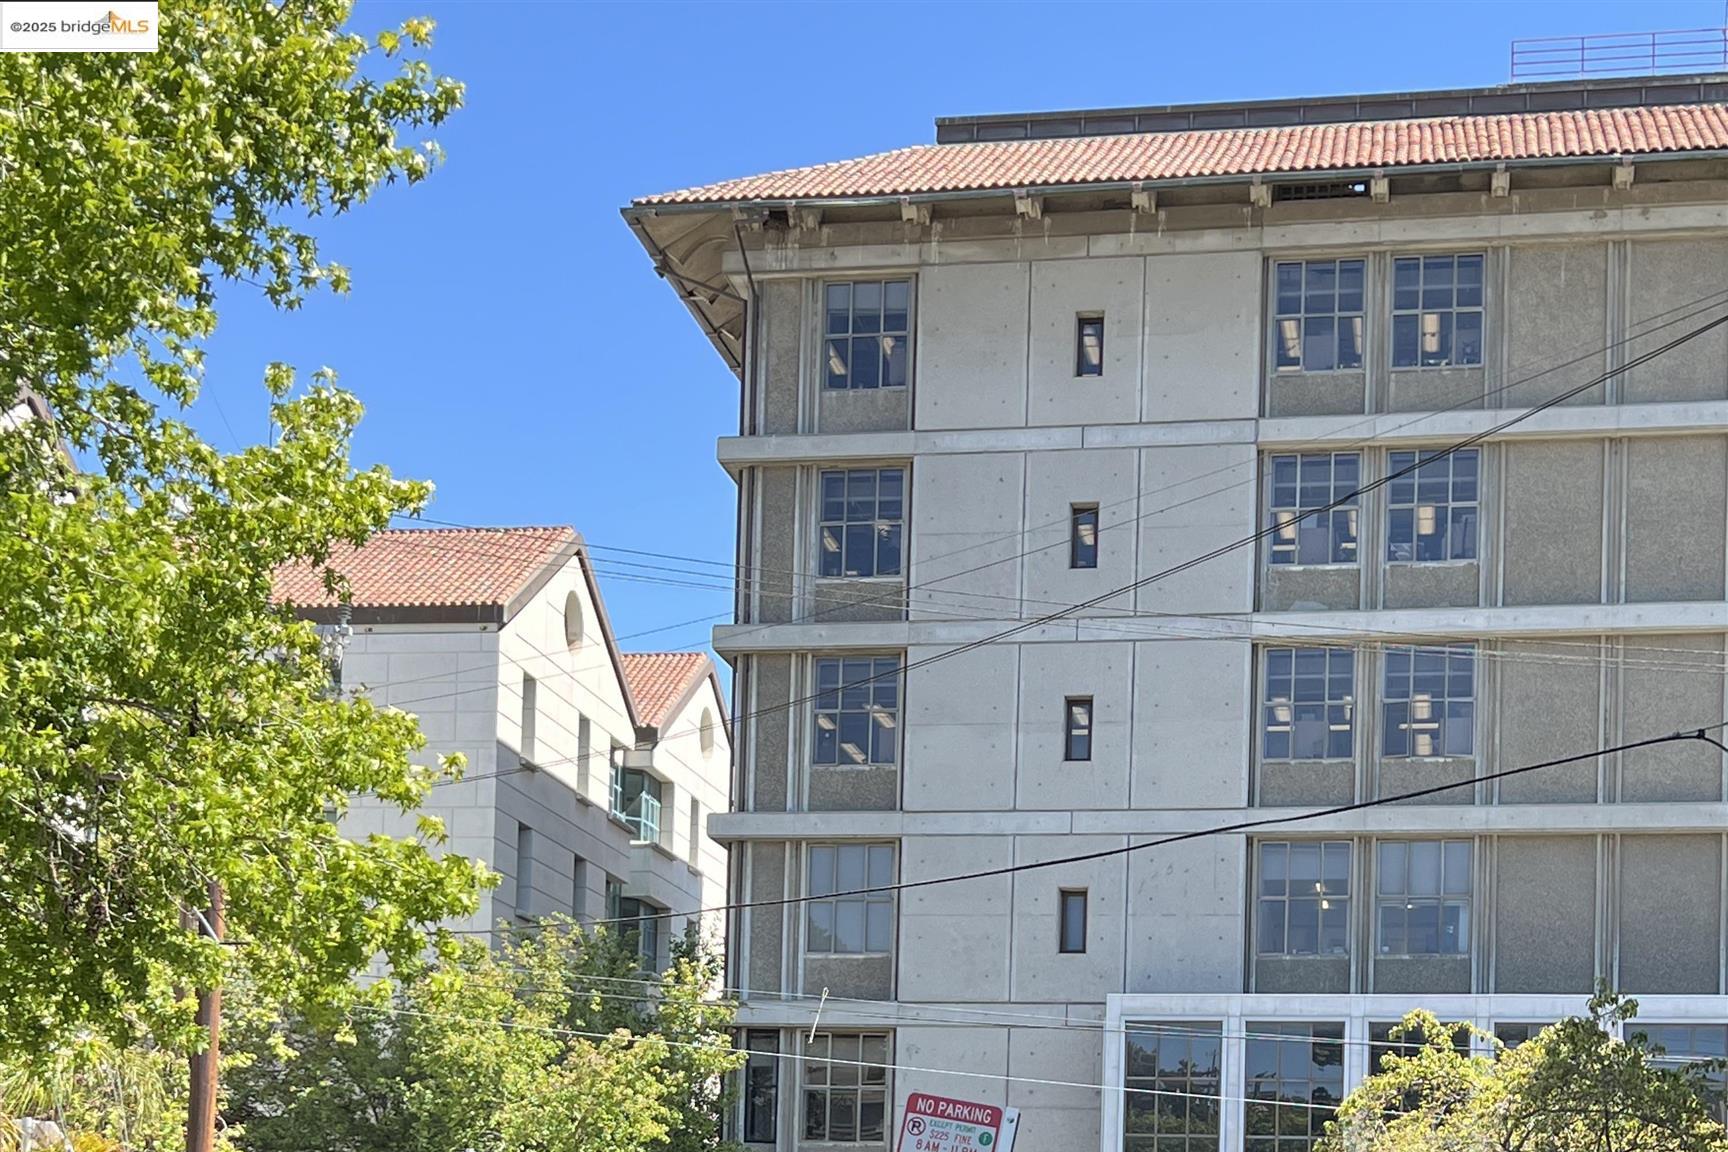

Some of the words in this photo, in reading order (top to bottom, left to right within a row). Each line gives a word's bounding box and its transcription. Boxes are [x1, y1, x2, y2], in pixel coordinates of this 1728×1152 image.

[916, 1097, 935, 1114] NO
[937, 1101, 992, 1123] PARKING
[928, 1129, 950, 1141] $225
[954, 1134, 973, 1145] FINE
